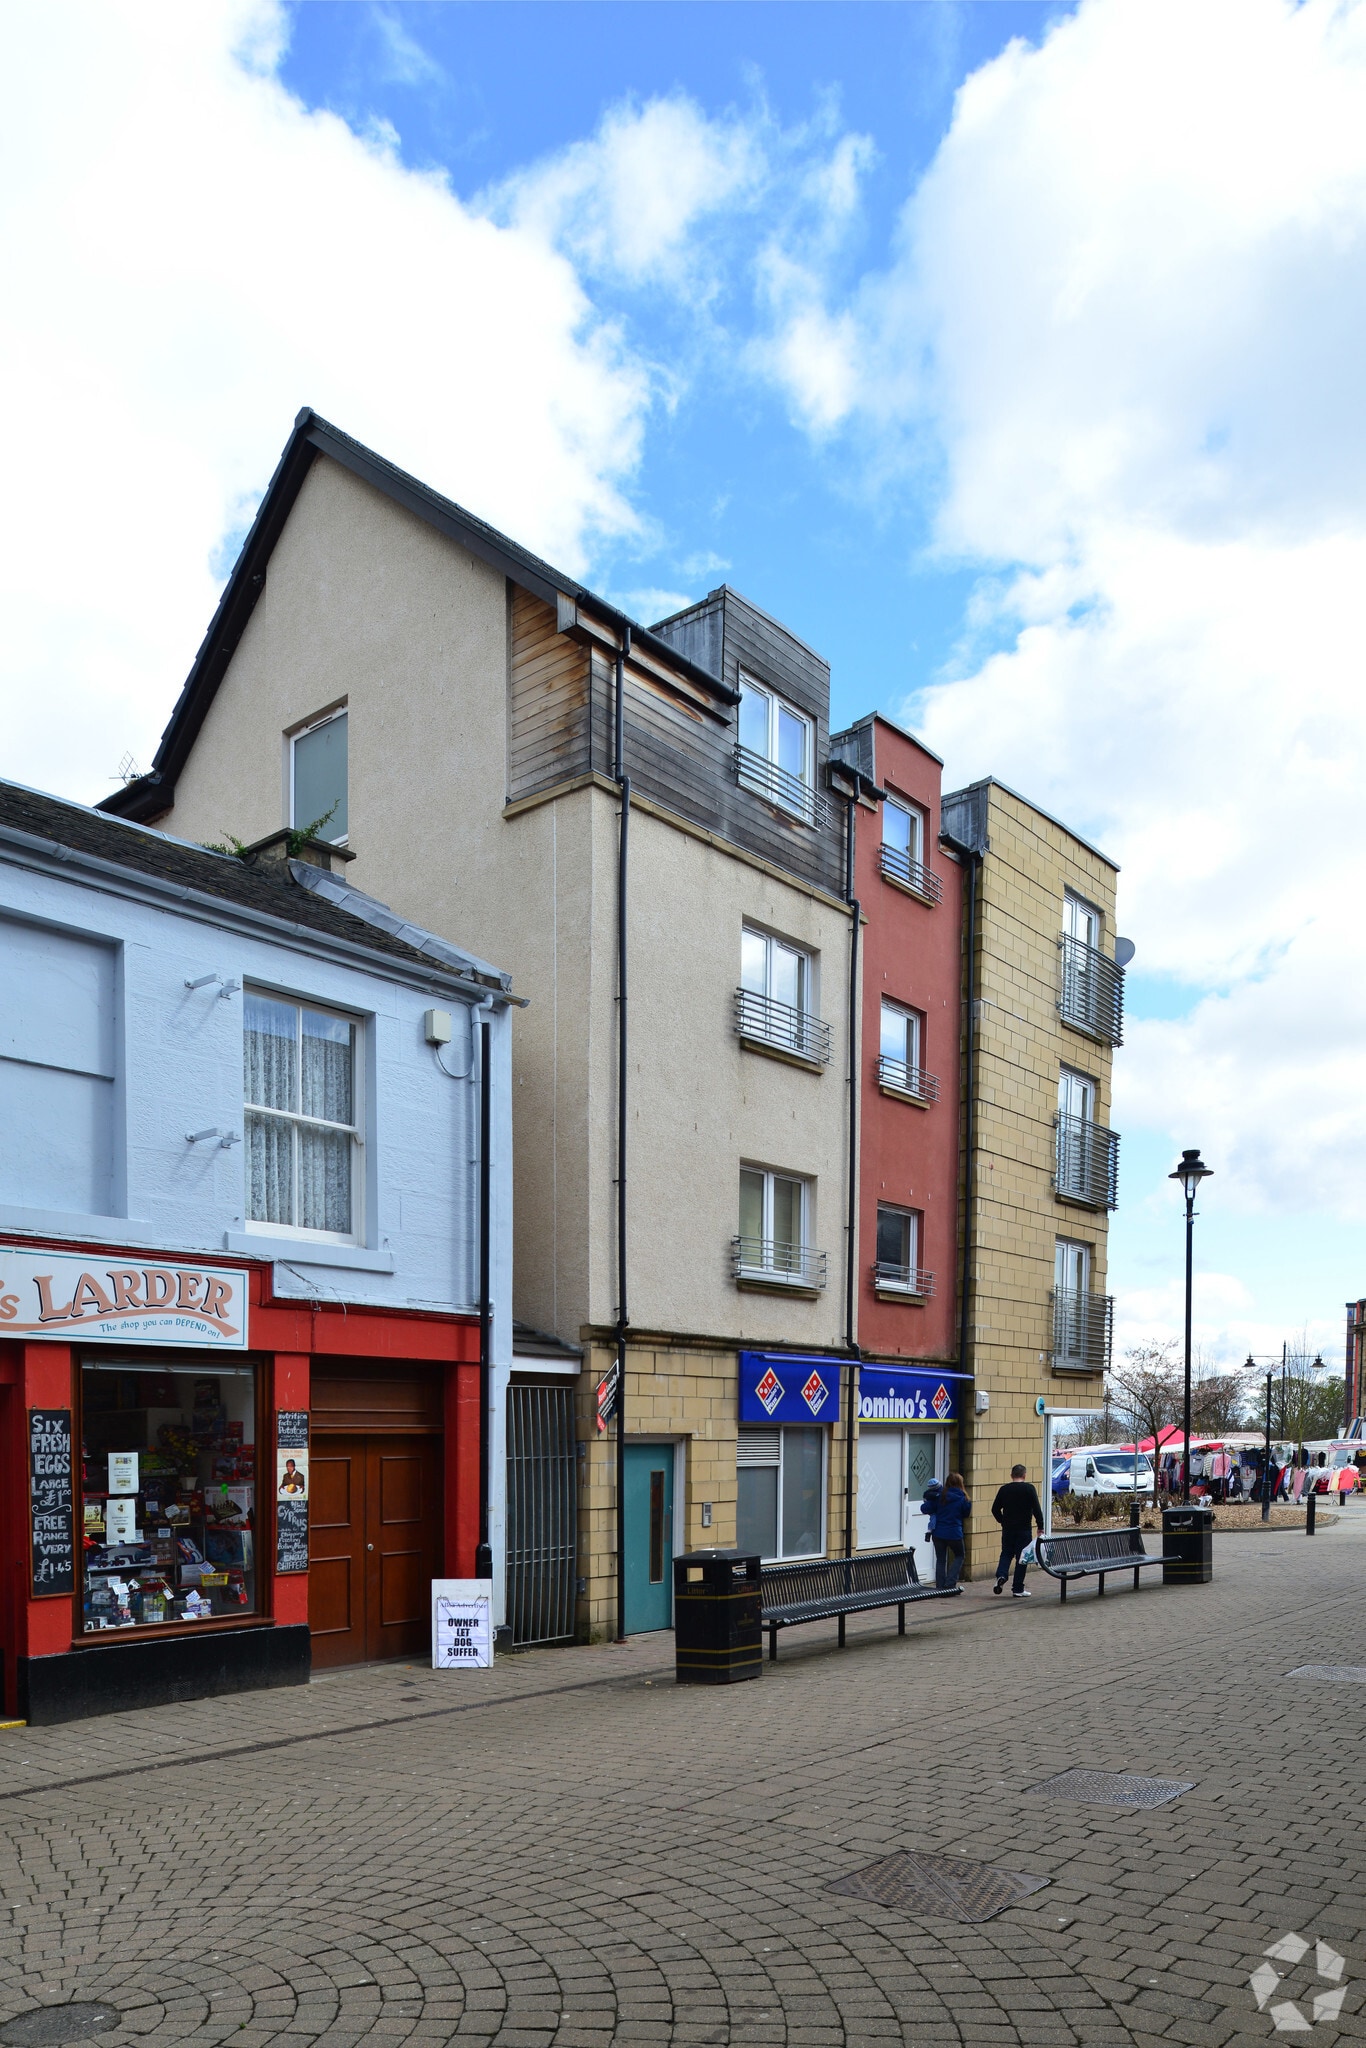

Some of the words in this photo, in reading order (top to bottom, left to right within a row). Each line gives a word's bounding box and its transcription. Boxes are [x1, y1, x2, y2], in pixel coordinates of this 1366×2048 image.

[33, 1270, 233, 1322] LARDER
[99, 1323, 117, 1333] The
[120, 1320, 140, 1330] shop
[142, 1319, 157, 1330] you
[175, 1317, 207, 1332] DEPEND
[31, 1433, 70, 1453] FRESH
[35, 1454, 70, 1474] EGGS
[31, 1476, 70, 1496] LARGE
[34, 1515, 67, 1531] FREE
[32, 1531, 69, 1545] RANGE
[39, 1544, 72, 1555] VERY
[448, 1618, 479, 1627] OWNER
[457, 1628, 470, 1636] LET
[454, 1638, 472, 1646] DOG
[447, 1648, 478, 1656] SUFFER
